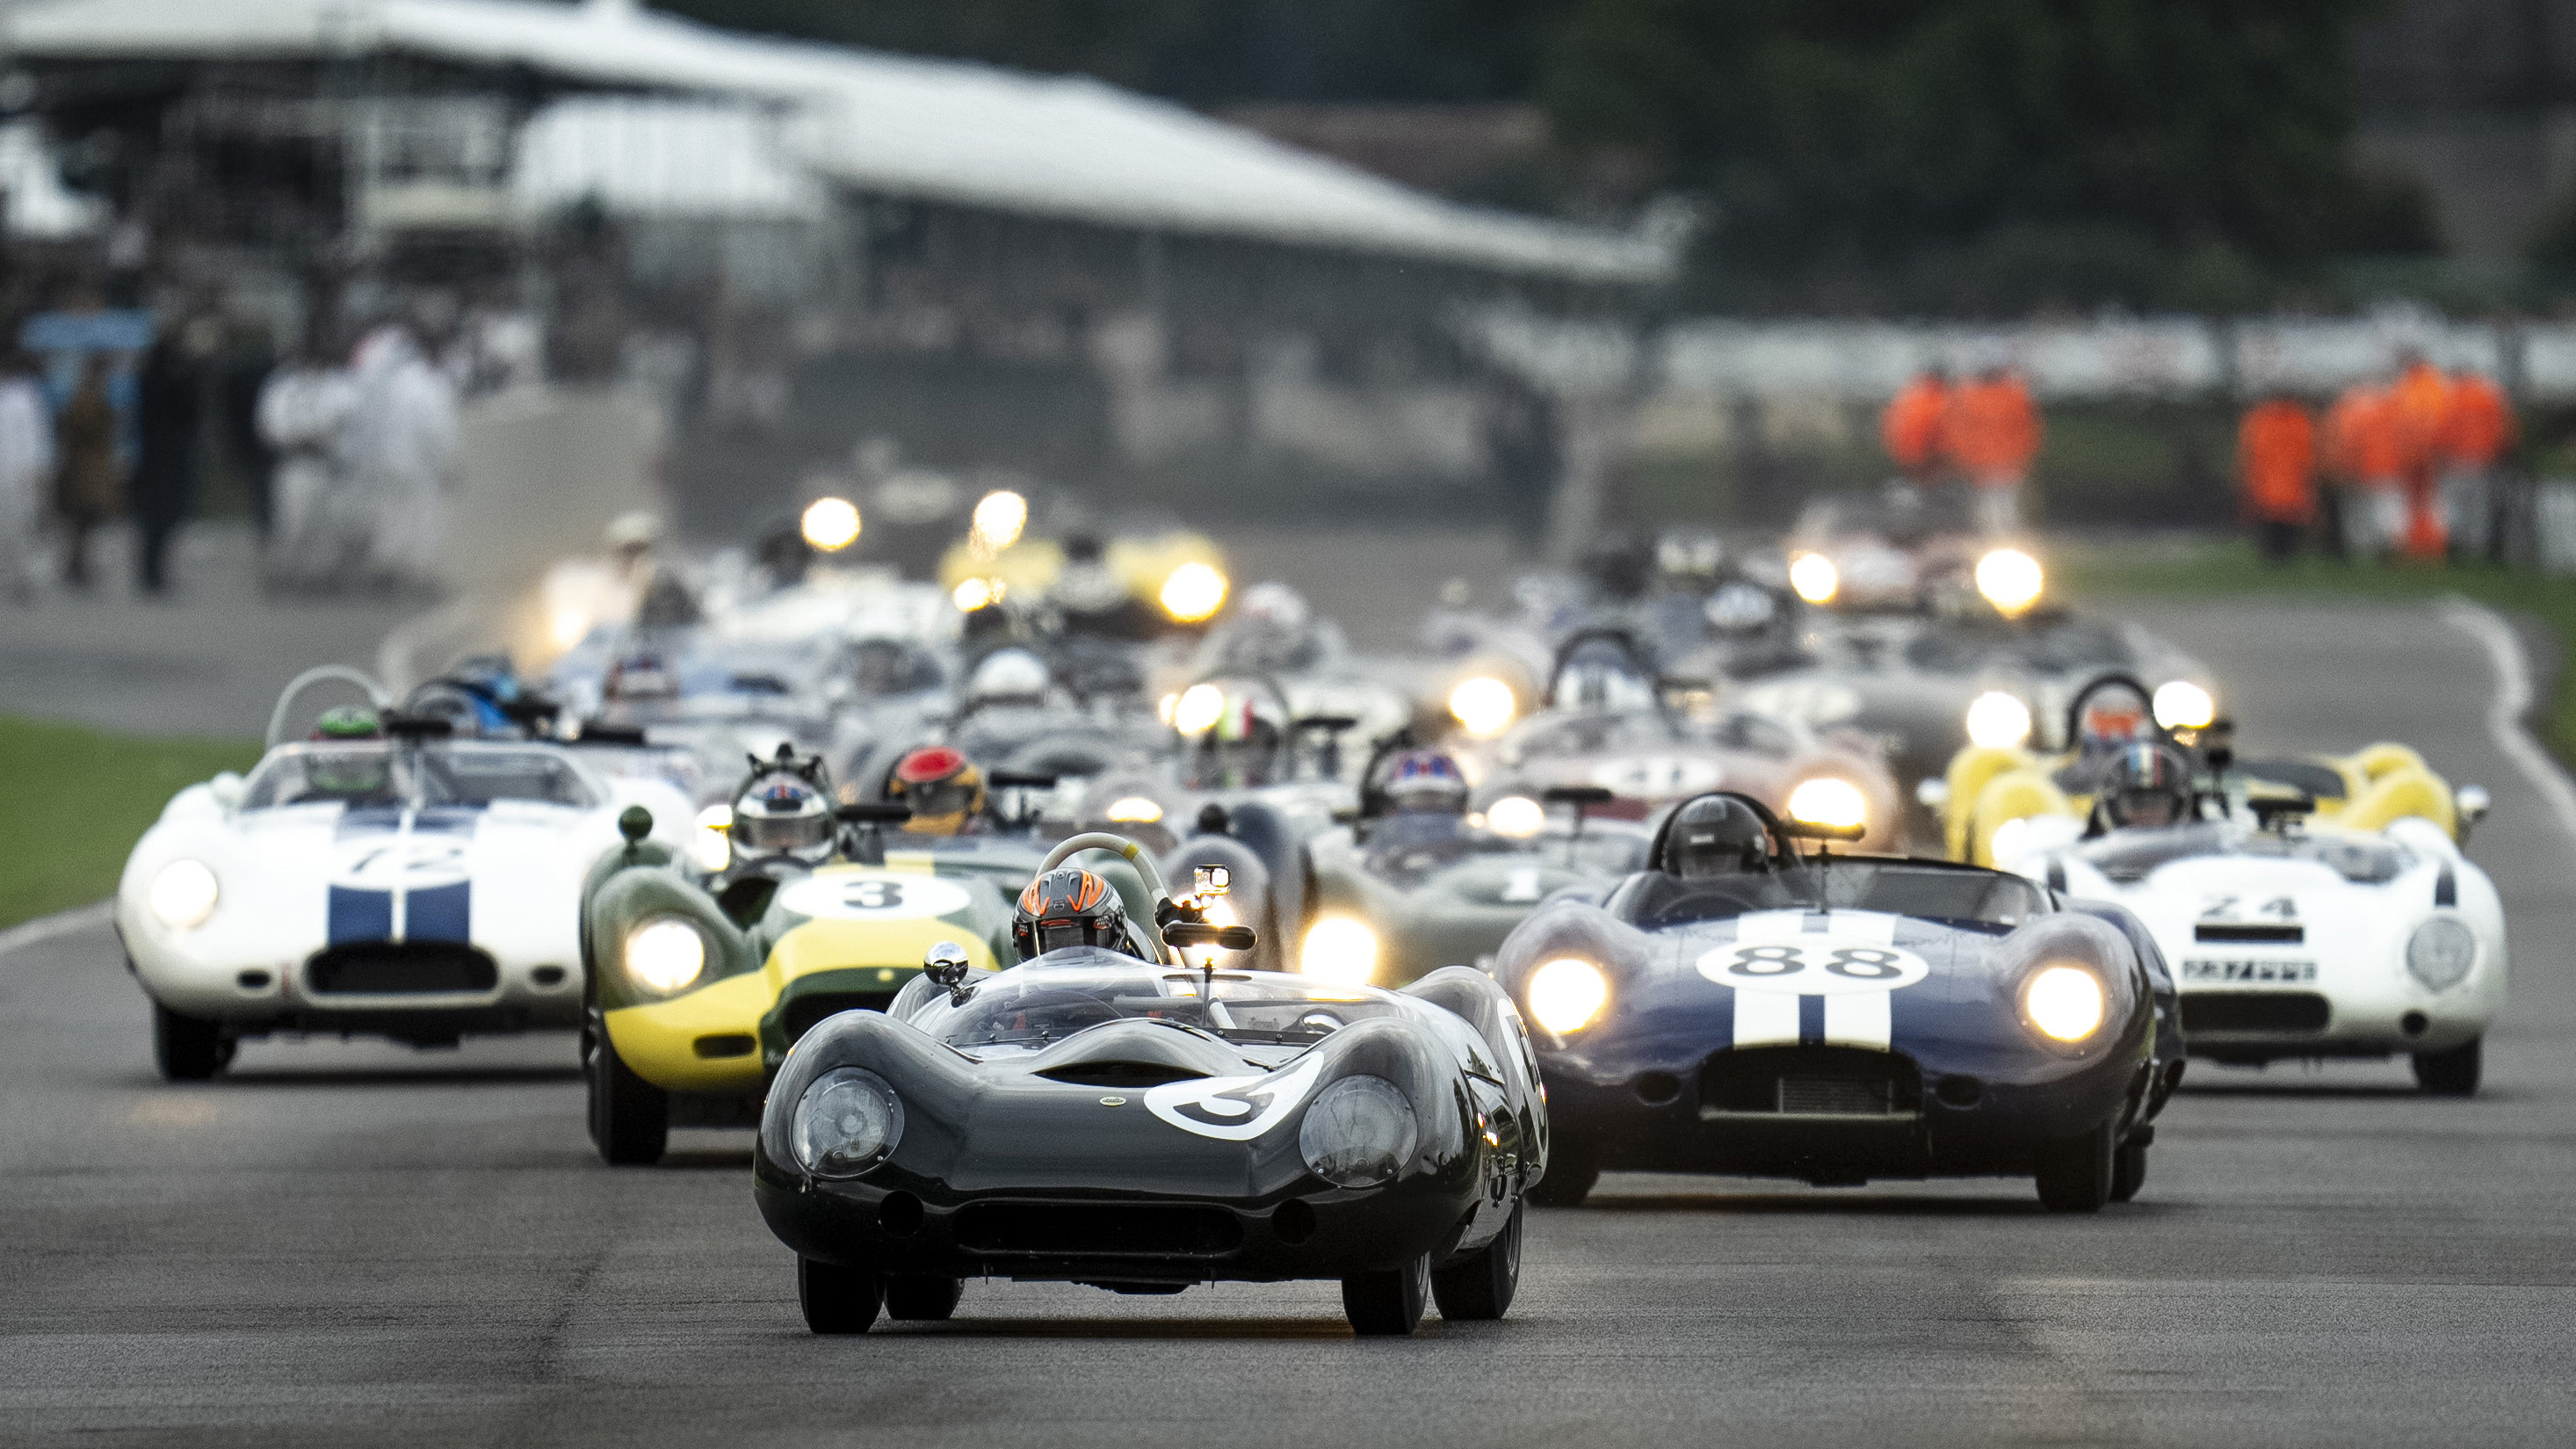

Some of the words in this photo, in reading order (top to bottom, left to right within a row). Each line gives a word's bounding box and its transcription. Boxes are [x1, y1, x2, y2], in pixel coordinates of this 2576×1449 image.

[843, 881, 903, 909] 3
[2199, 894, 2298, 921] 24
[1728, 945, 1902, 979] 88
[1173, 1056, 1313, 1127] 3
